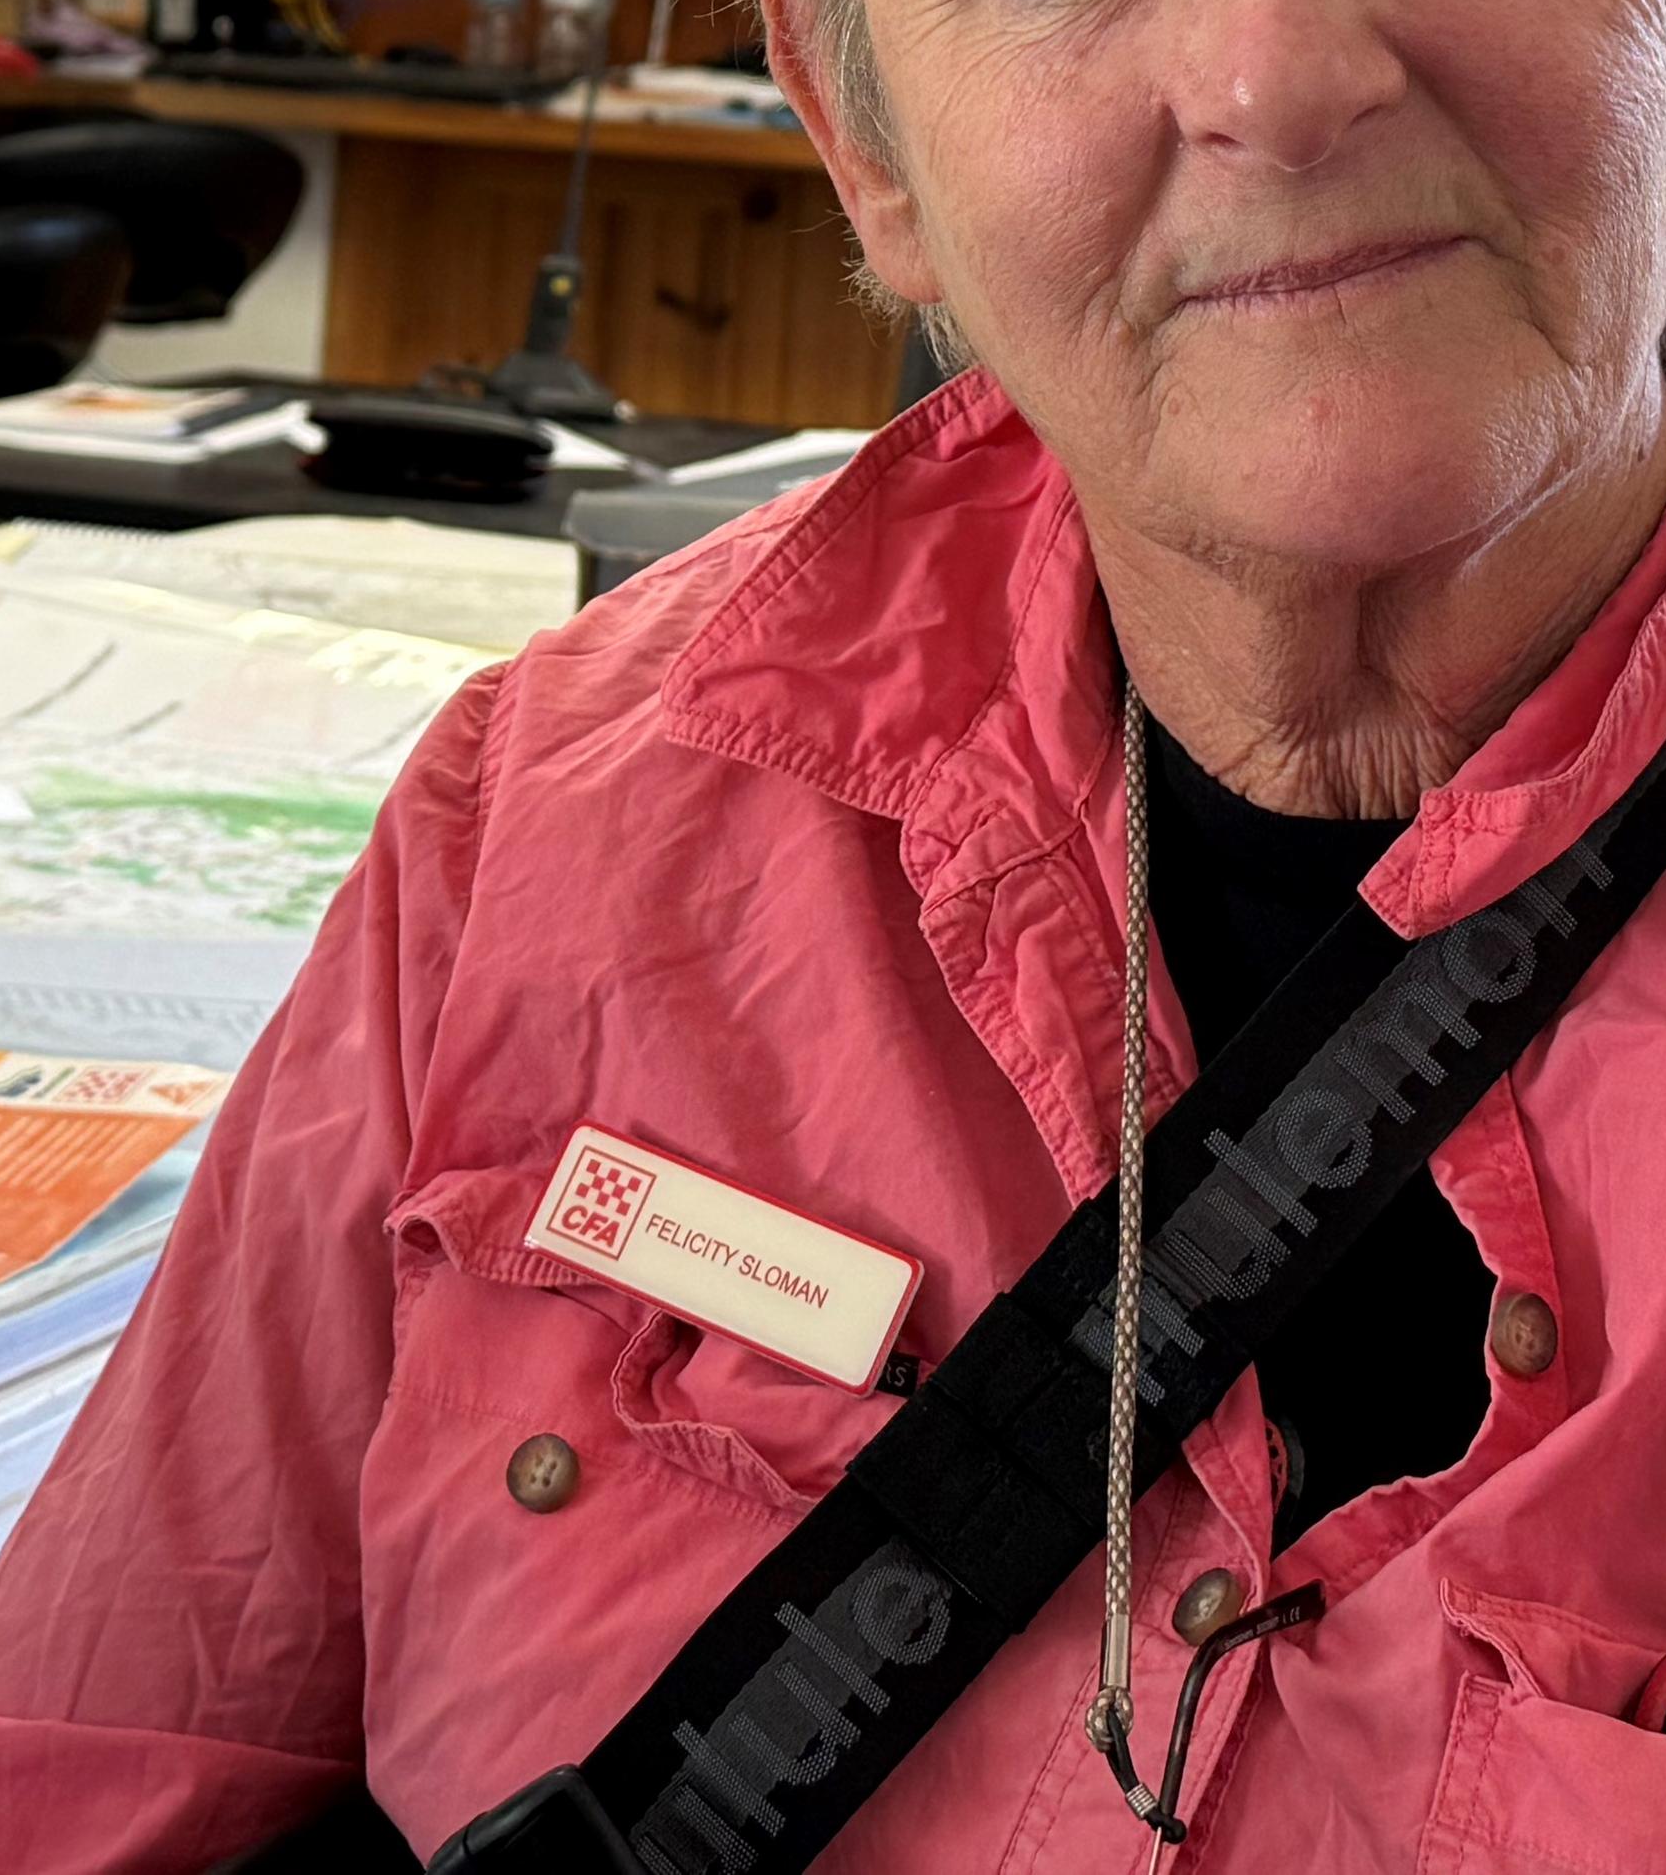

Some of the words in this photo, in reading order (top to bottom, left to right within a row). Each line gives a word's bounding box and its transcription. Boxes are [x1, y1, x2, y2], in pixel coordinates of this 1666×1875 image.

[561, 1204, 622, 1249] CFA
[645, 1212, 739, 1267] FELICITY
[737, 1253, 831, 1310] SLOMAN
